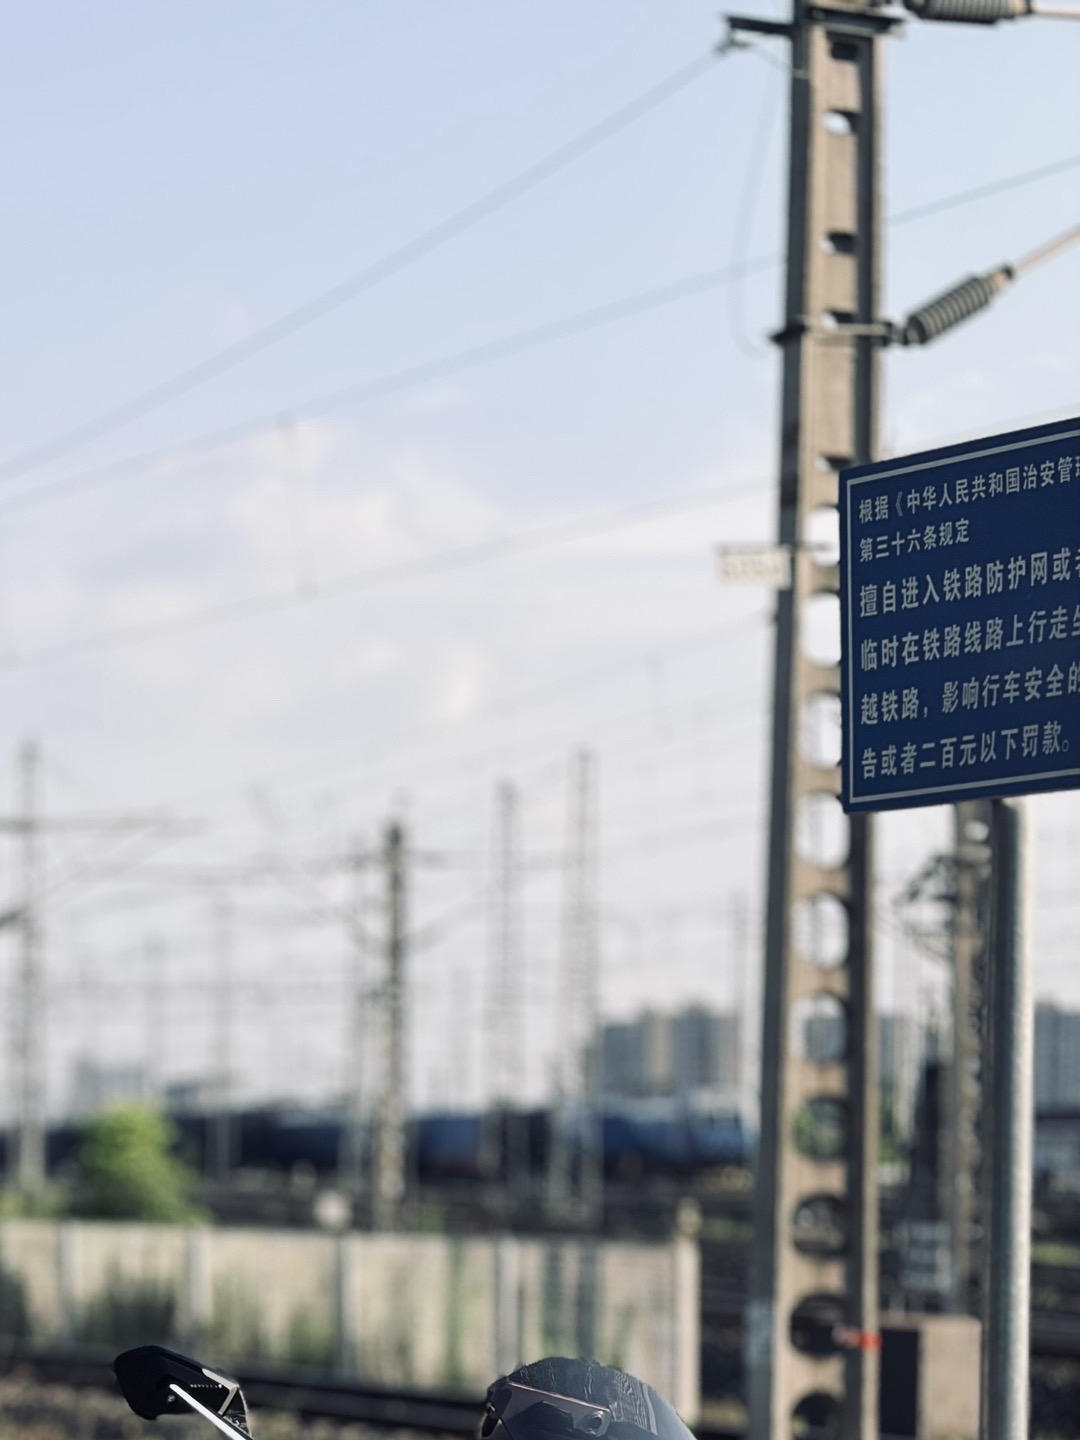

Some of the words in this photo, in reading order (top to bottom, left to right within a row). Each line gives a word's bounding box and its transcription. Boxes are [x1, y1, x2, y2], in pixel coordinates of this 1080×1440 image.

[859, 517, 970, 562] 第三十六条规定
[859, 547, 1080, 618] 擅自进入铁路防护网或
[862, 720, 1069, 780] 告或者二百元以下罚款。
